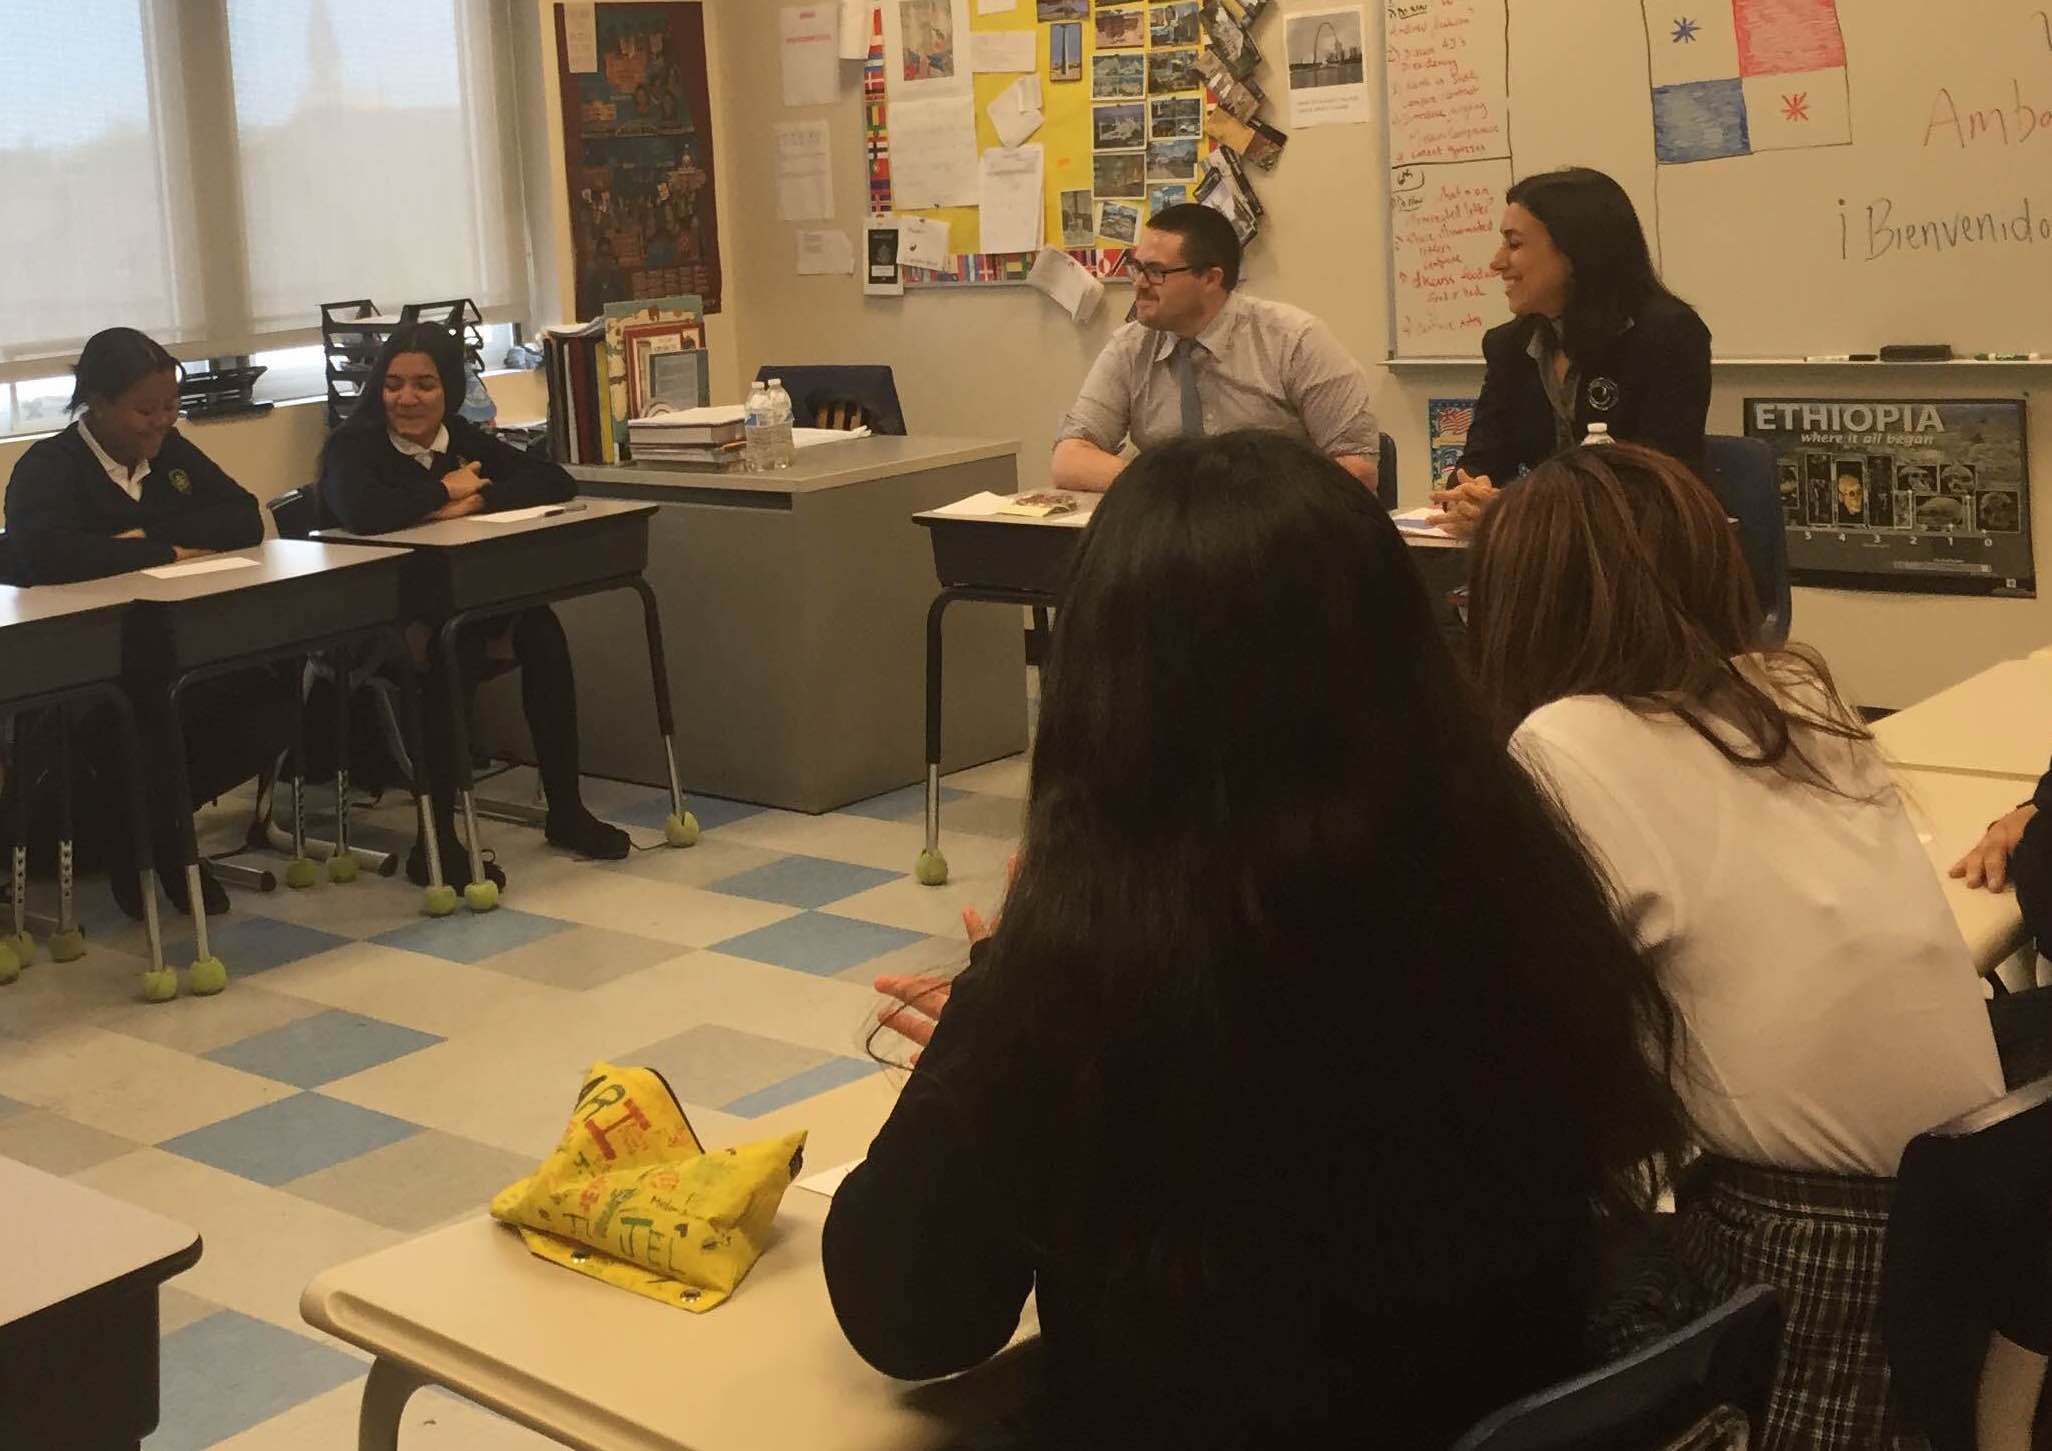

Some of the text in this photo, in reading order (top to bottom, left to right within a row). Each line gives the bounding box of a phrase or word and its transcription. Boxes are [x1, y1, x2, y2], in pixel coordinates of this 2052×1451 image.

[1755, 403, 1945, 433] ETHIOPIA
[1801, 432, 1934, 448] where it all began
[1838, 530, 1847, 542] 4
[1873, 533, 1882, 544] 3
[1909, 535, 1919, 546] 2
